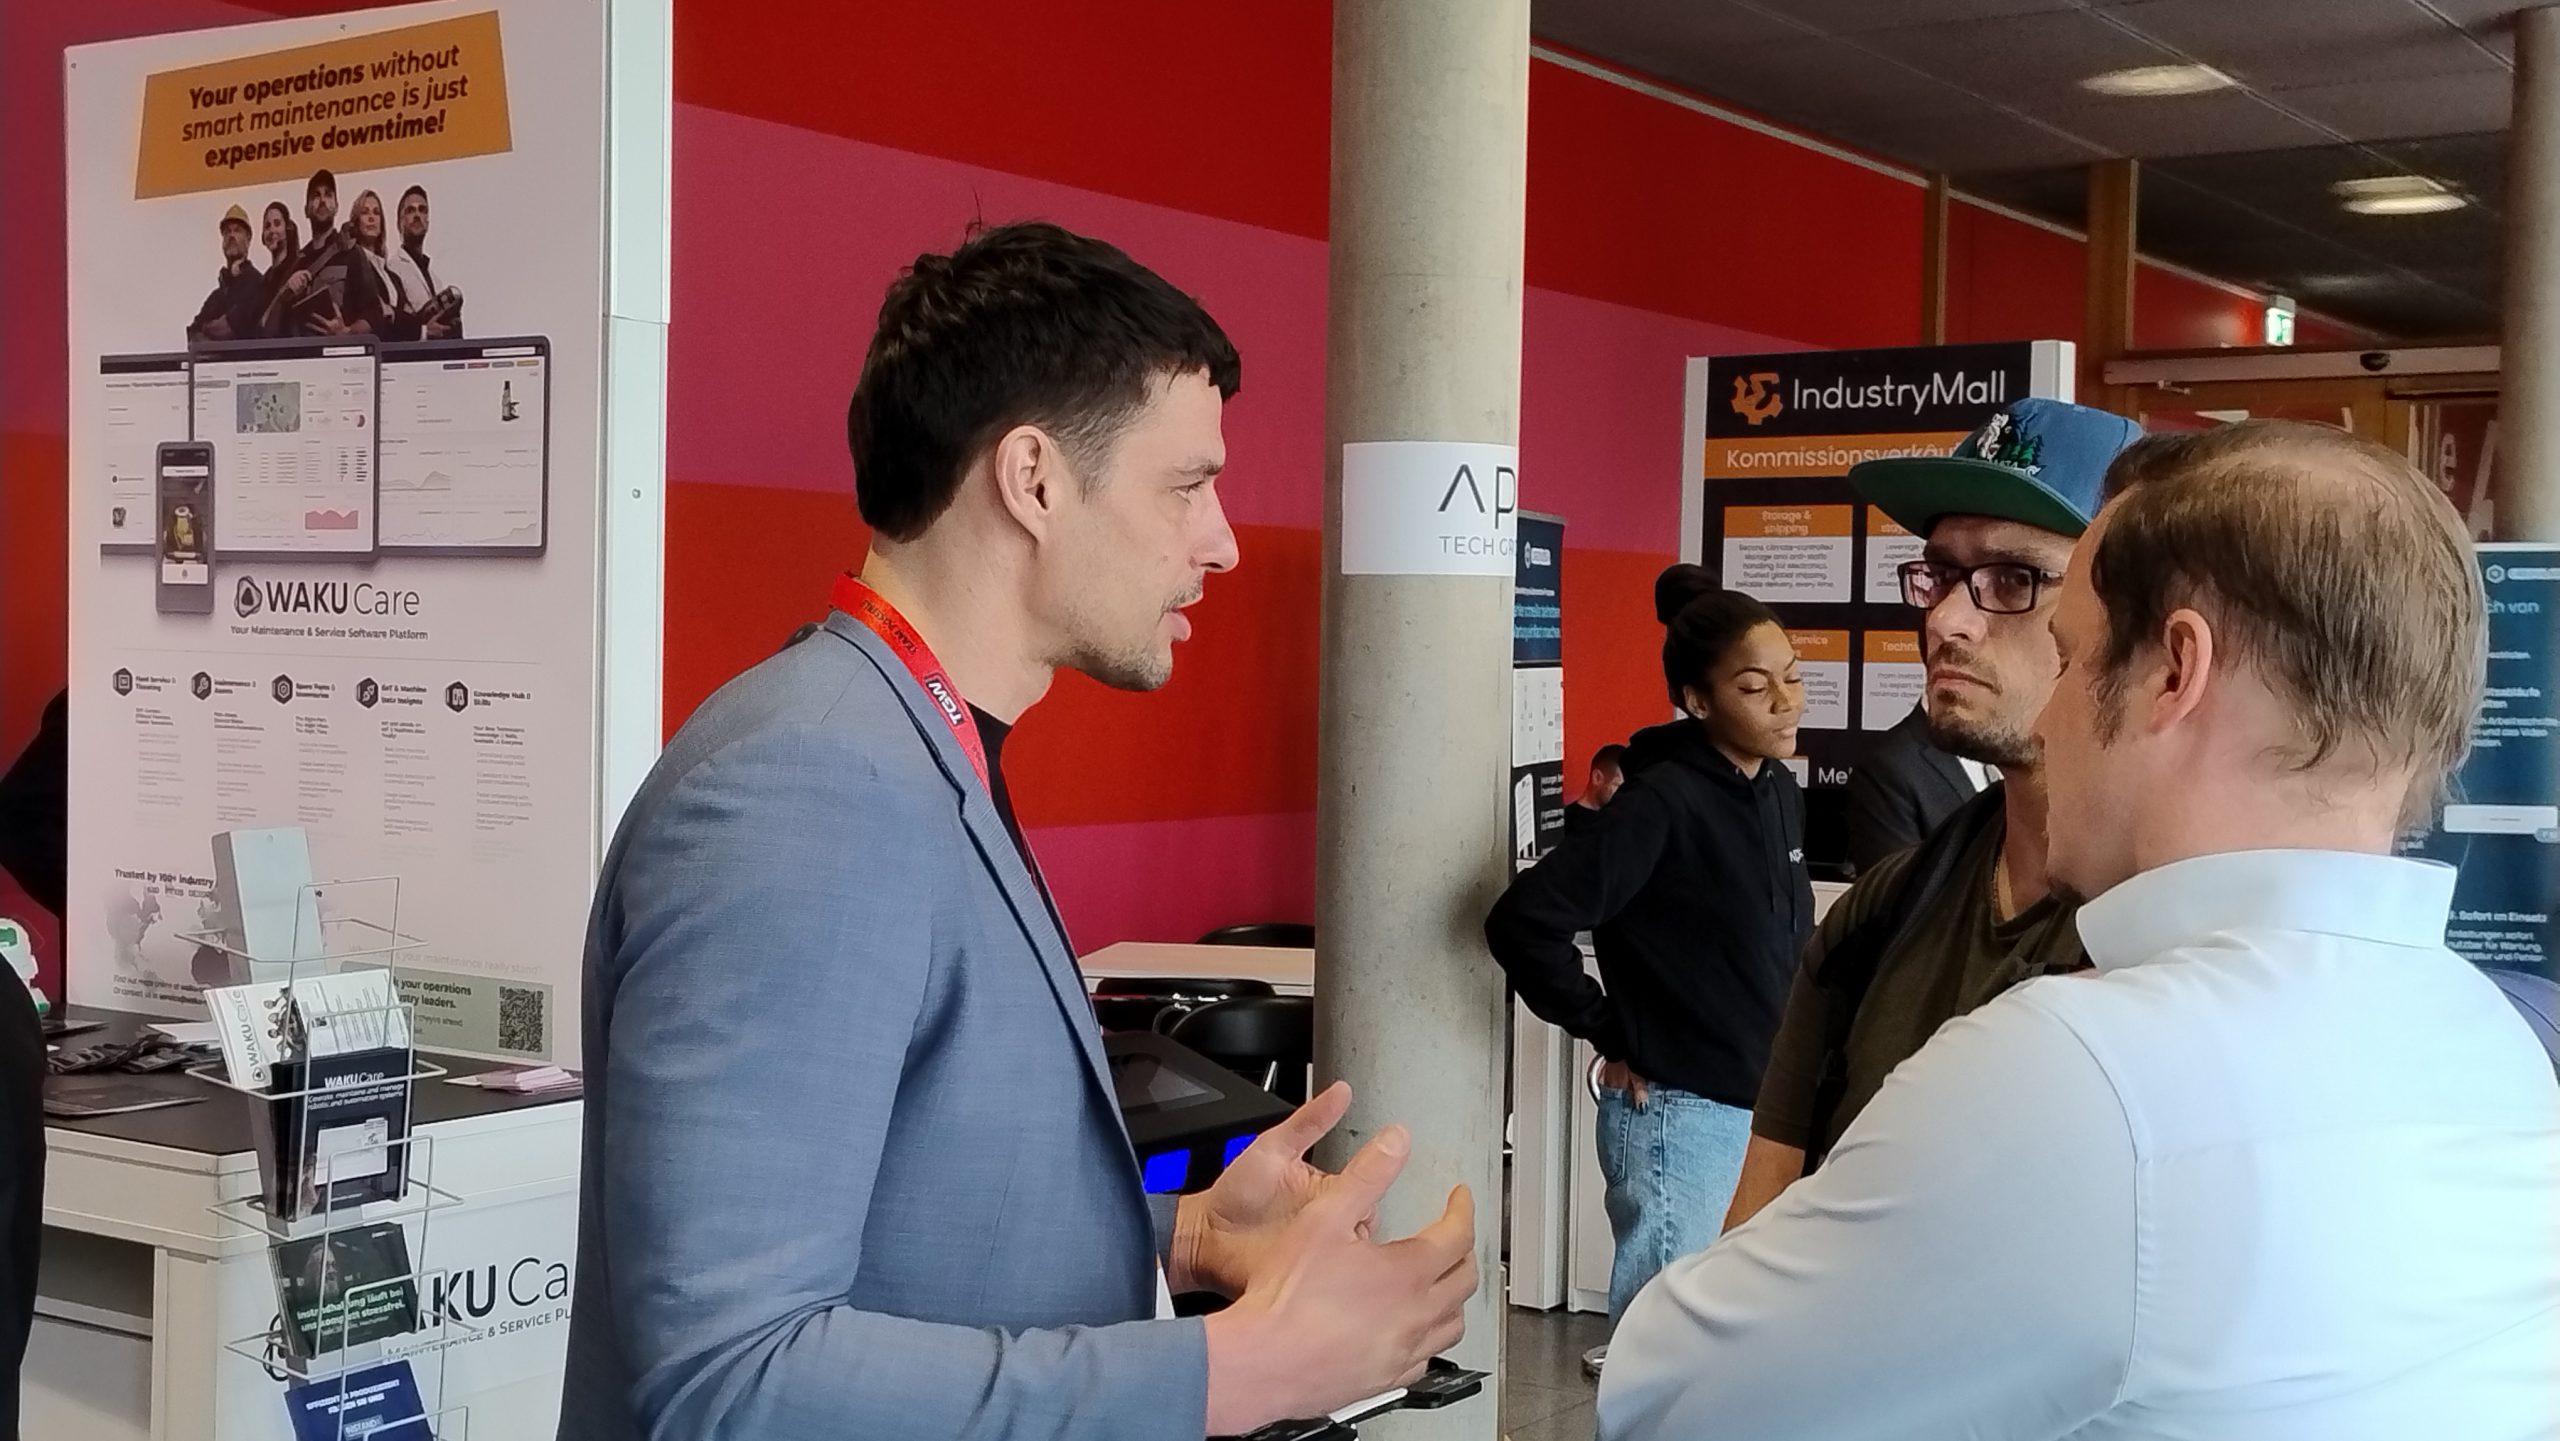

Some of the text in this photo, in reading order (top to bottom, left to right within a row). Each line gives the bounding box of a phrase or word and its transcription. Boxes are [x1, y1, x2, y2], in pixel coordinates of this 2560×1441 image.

[189, 45, 460, 110] Your operations without
[182, 74, 469, 142] smart maintenance is just
[204, 109, 447, 170] expensive downtime!
[1793, 370, 2006, 415] IndustryMall
[1438, 535, 1495, 555] TECH
[266, 581, 420, 616] WAKU Care
[230, 625, 249, 635] Your
[251, 626, 305, 637] Maintenance
[315, 627, 346, 638] Service
[348, 628, 387, 639] Software
[389, 629, 428, 640] Platform
[927, 682, 963, 726] TGW
[115, 869, 145, 880] Trusted
[147, 871, 157, 883] by
[179, 874, 214, 889] industry
[401, 979, 422, 992] your
[423, 980, 472, 996] operations
[240, 1024, 259, 1067] WAKU
[324, 1071, 385, 1089] WAKU Care
[419, 1264, 497, 1331] KU
[487, 1326, 496, 1338] &
